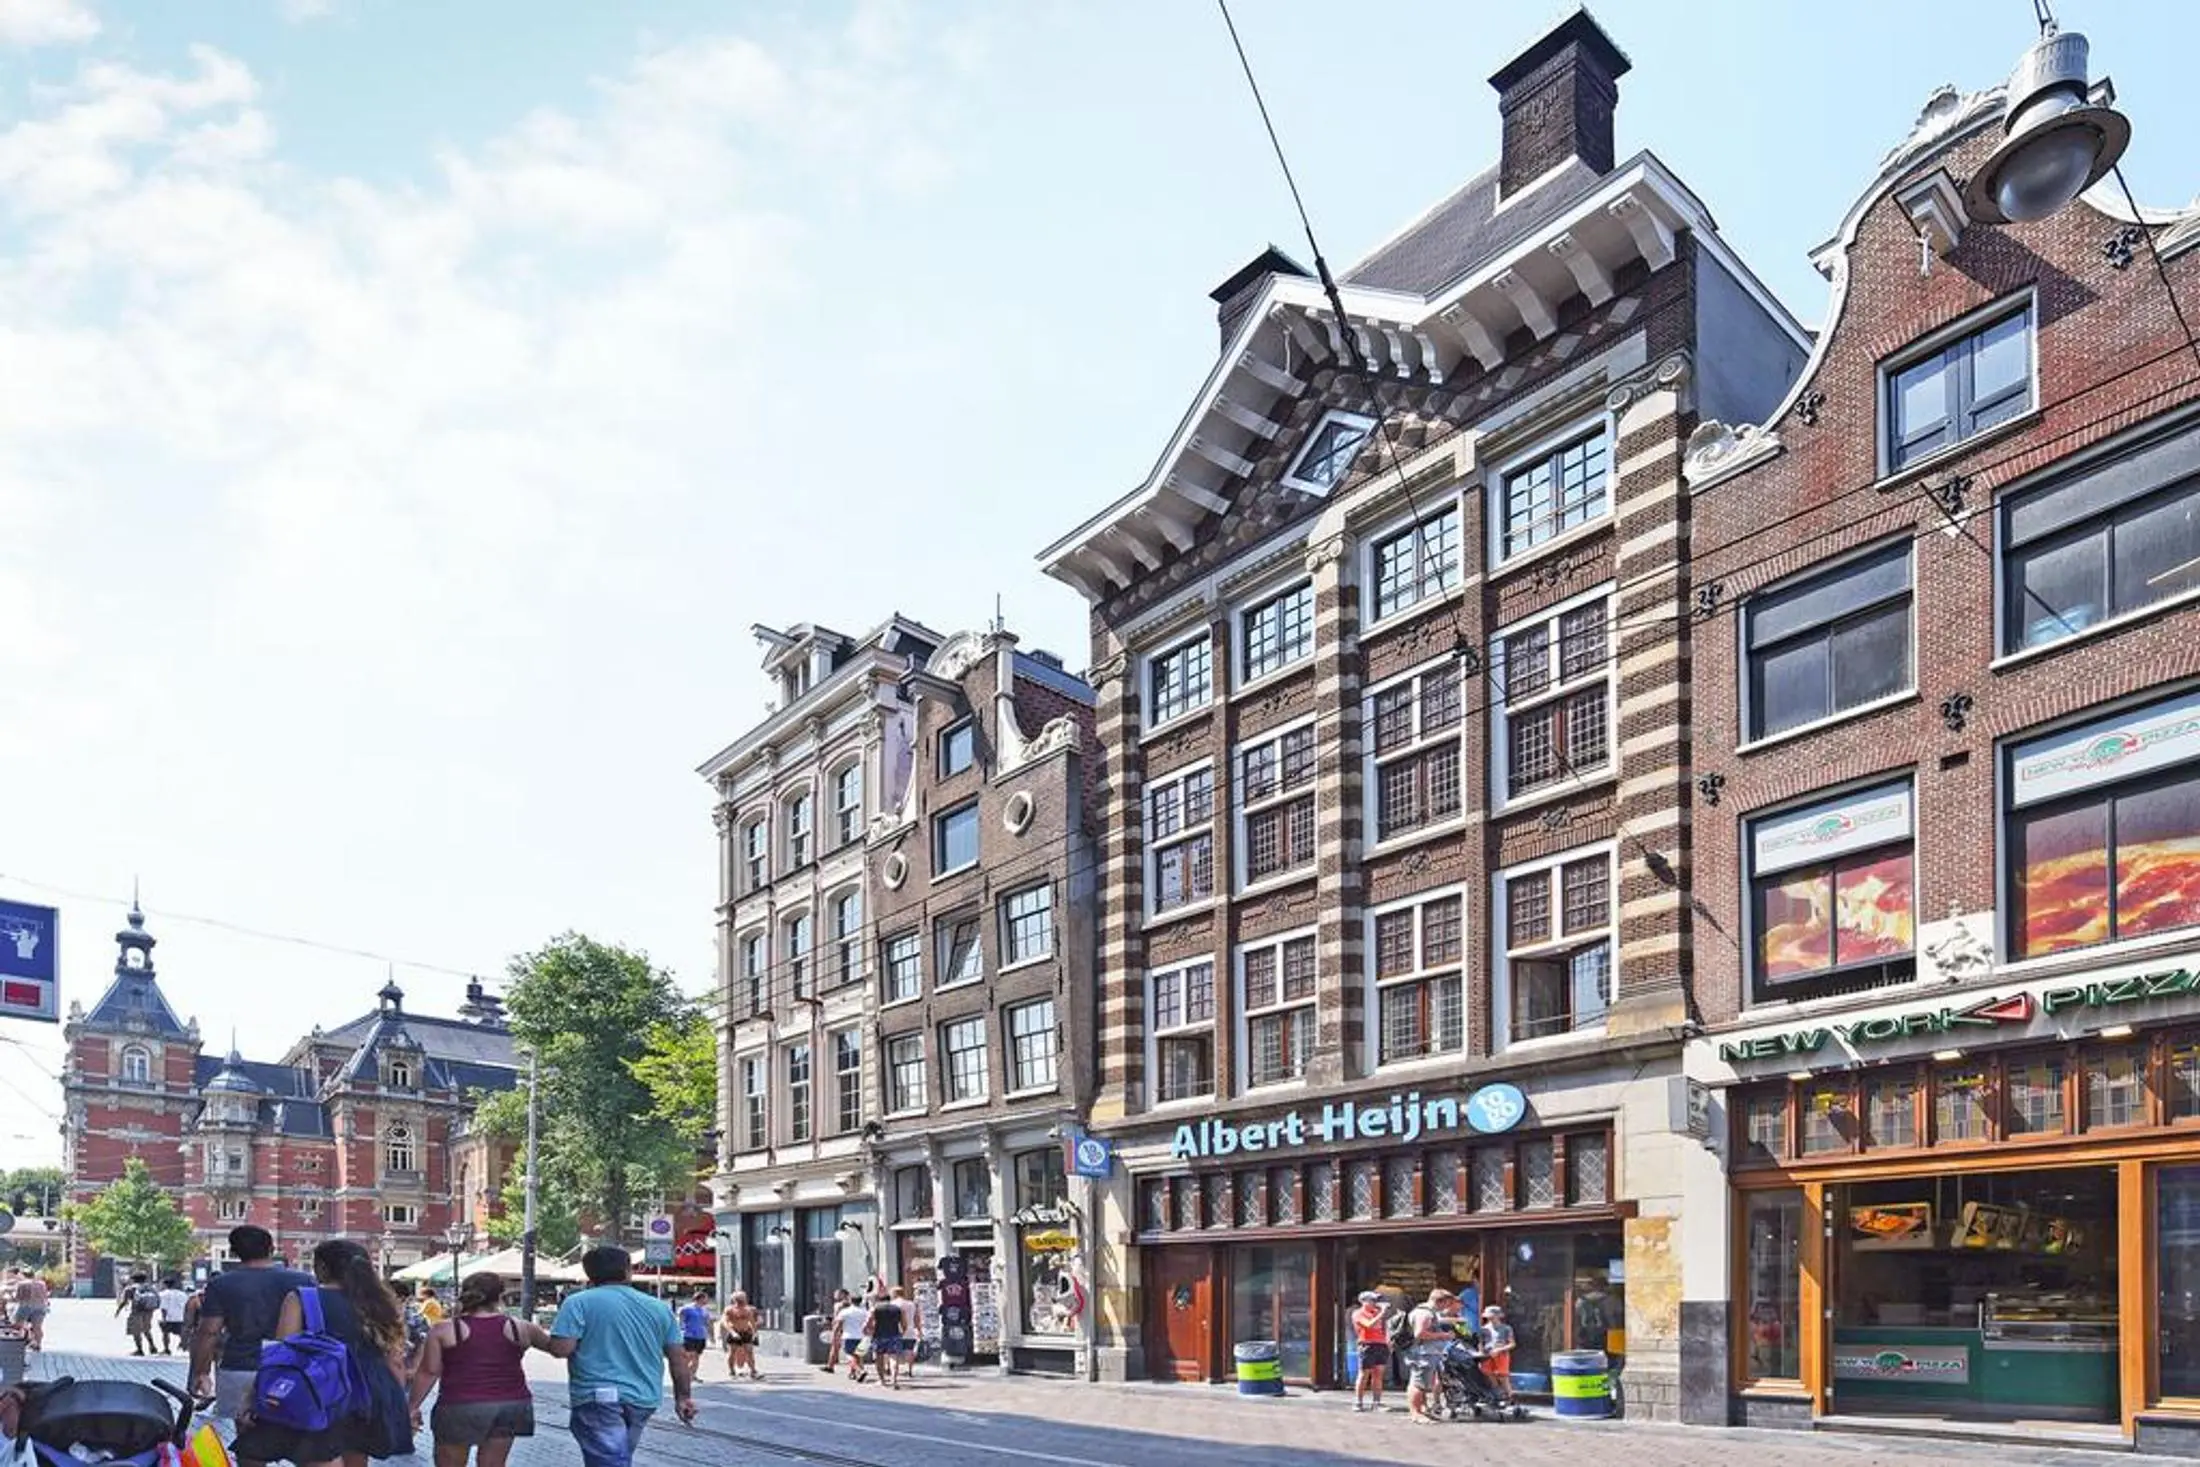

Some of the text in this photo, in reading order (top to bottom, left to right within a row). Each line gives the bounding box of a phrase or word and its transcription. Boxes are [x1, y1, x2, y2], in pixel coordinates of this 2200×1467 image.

[1719, 1026, 1830, 1062] NEW
[1832, 996, 1999, 1046] YORK
[1170, 1091, 1459, 1160] Albert Heijn
